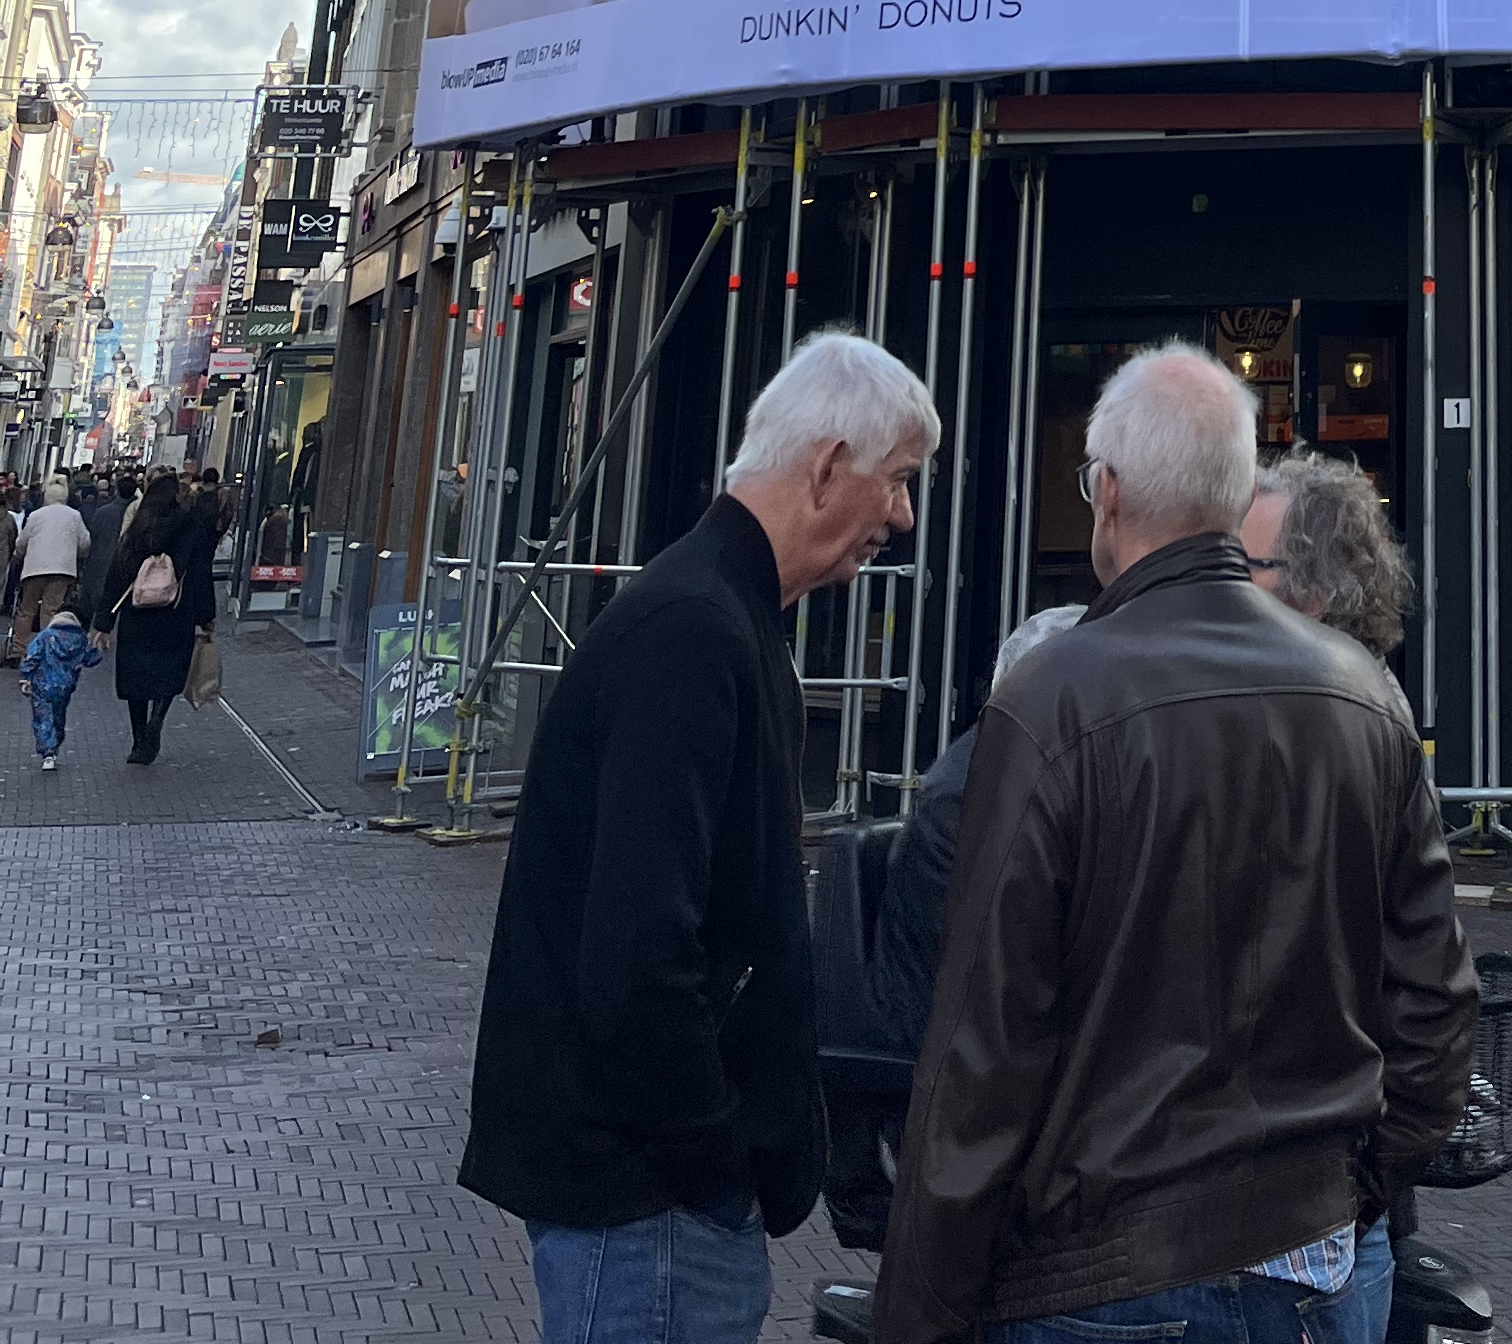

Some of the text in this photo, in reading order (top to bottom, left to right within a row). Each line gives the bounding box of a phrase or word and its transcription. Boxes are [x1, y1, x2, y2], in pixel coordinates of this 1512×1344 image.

[740, 4, 861, 44] DUNKIN'
[270, 99, 341, 113] TE HUUR
[264, 223, 289, 235] WAM
[254, 305, 288, 313] NELSON
[248, 317, 292, 336] aerie
[1453, 402, 1462, 424] 1
